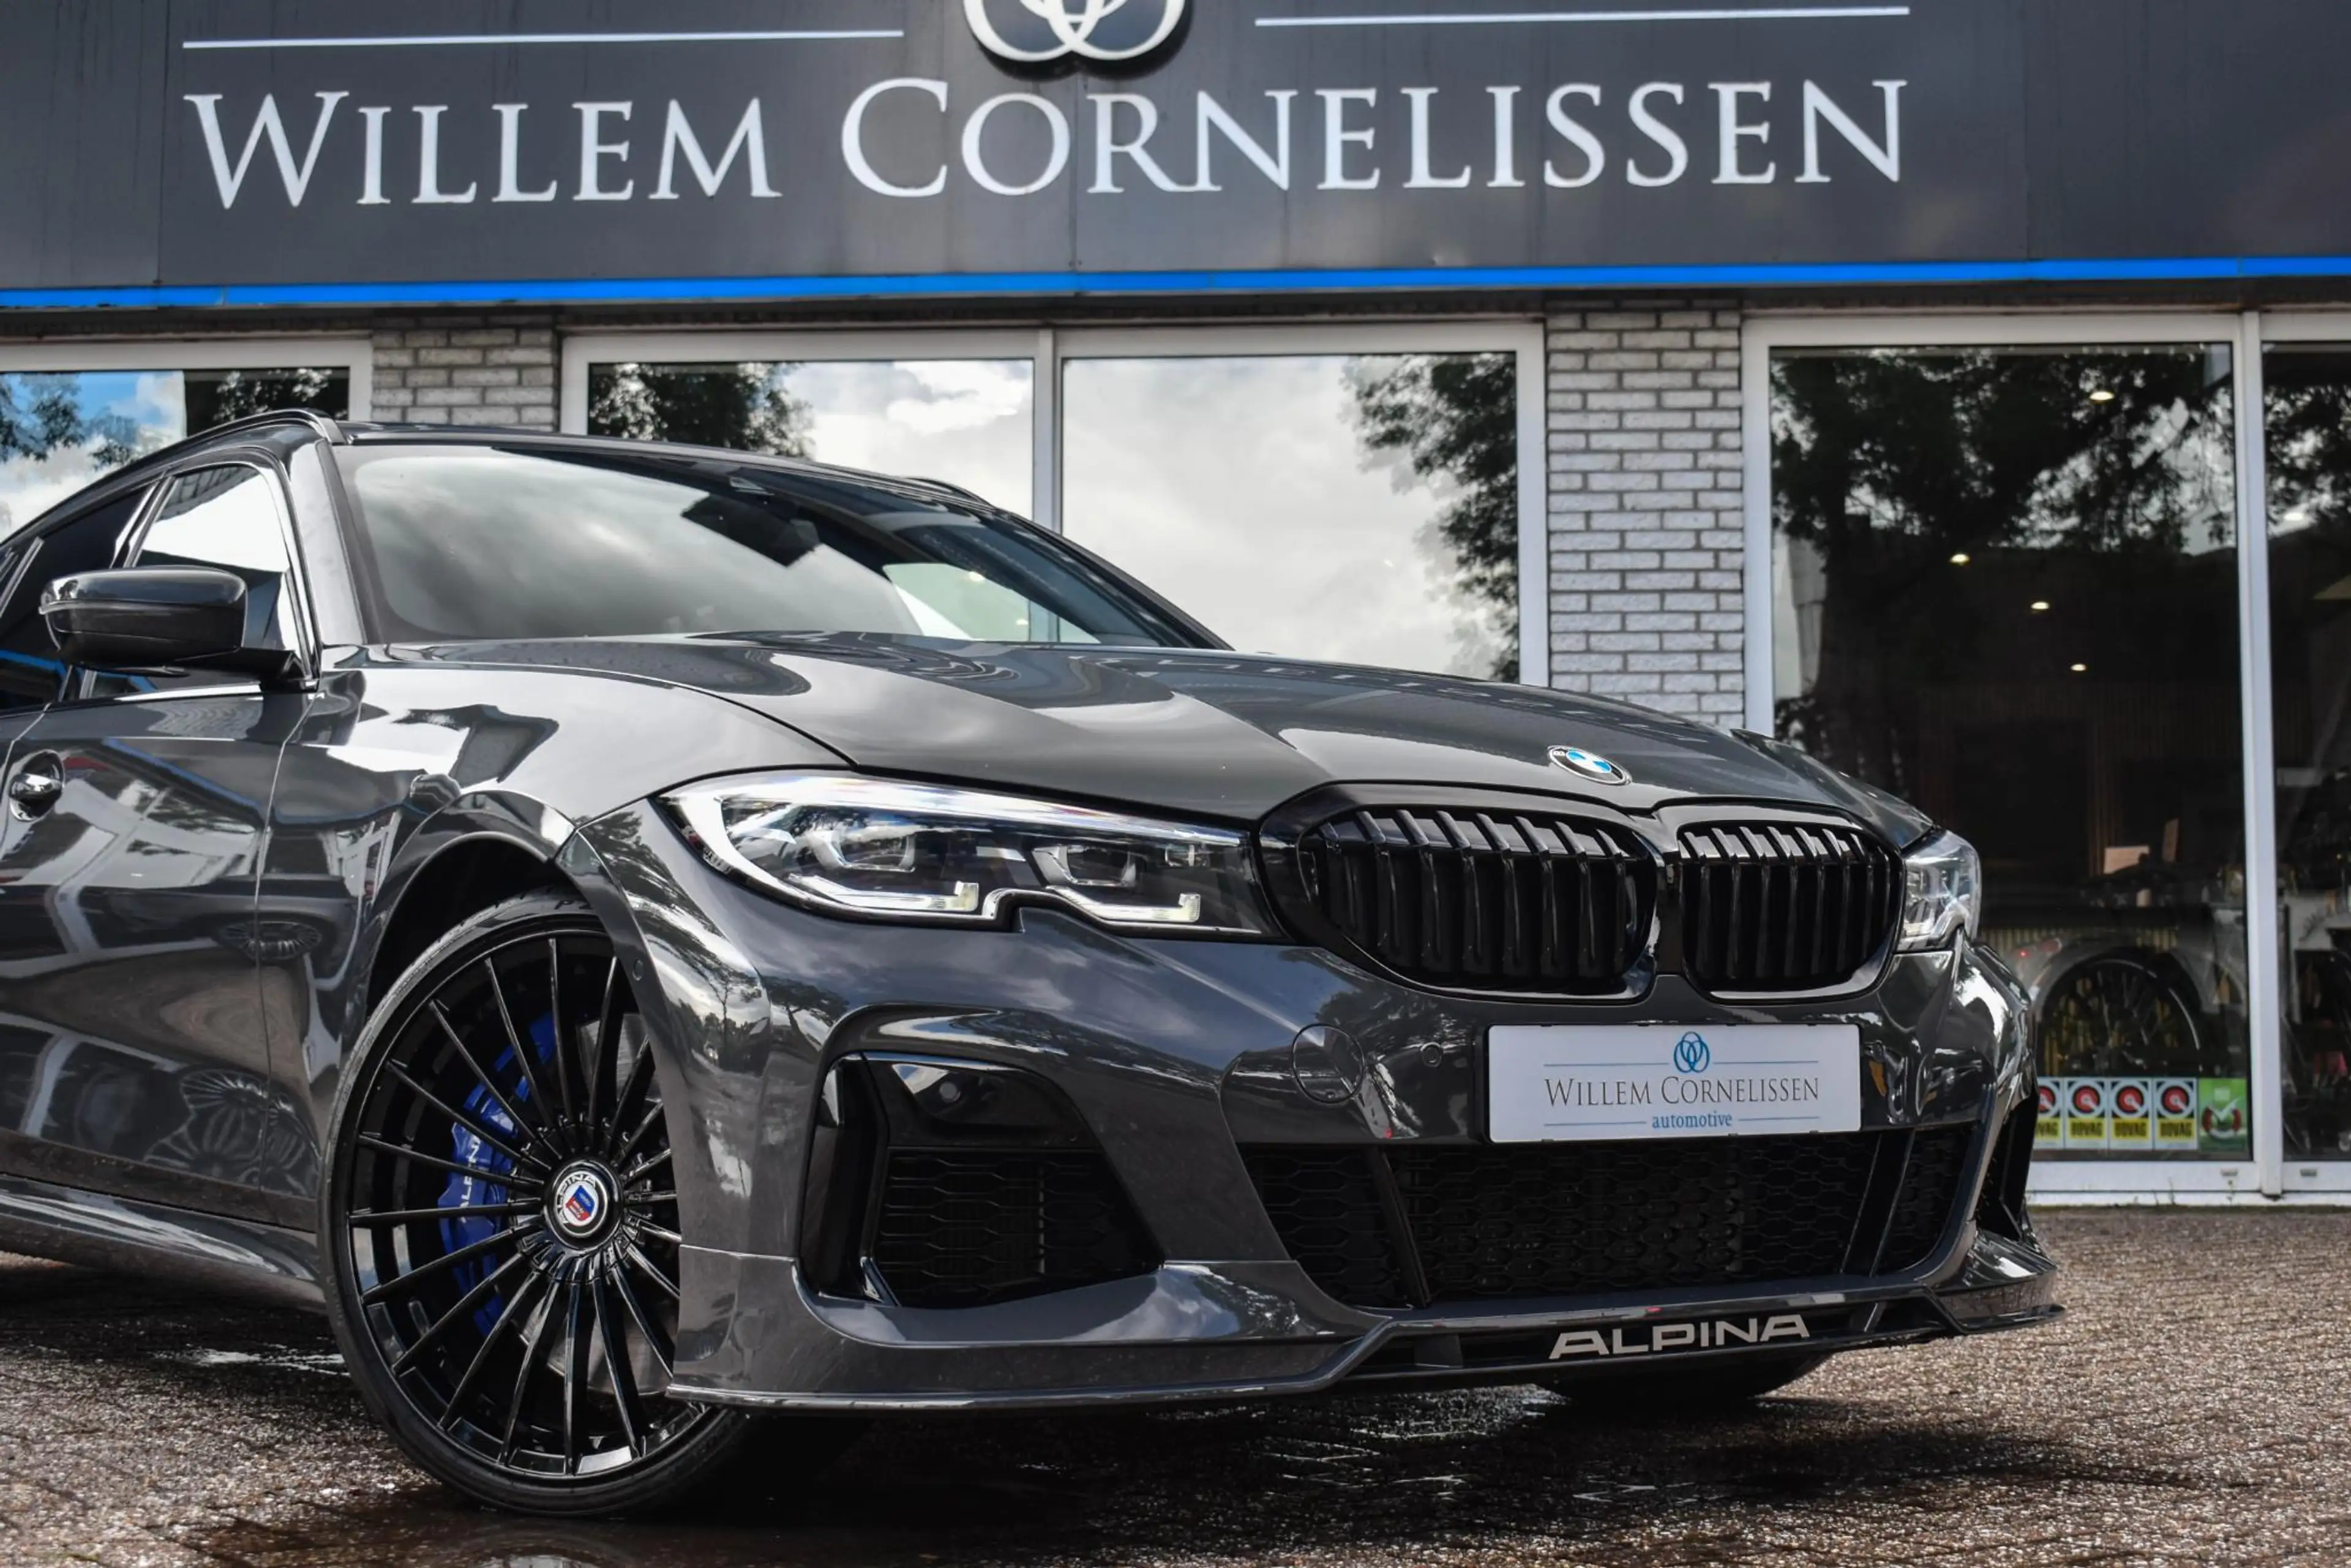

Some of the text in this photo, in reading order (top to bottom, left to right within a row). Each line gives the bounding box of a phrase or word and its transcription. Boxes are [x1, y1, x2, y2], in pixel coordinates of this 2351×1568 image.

[183, 77, 1907, 209] WILLEM CORNELISSEN
[1545, 1075, 1819, 1106] WILLEM CORNELISSEN
[1652, 1110, 1733, 1129] automotive
[556, 1172, 596, 1224] ALPINA
[1548, 1313, 1810, 1360] ALPINA
